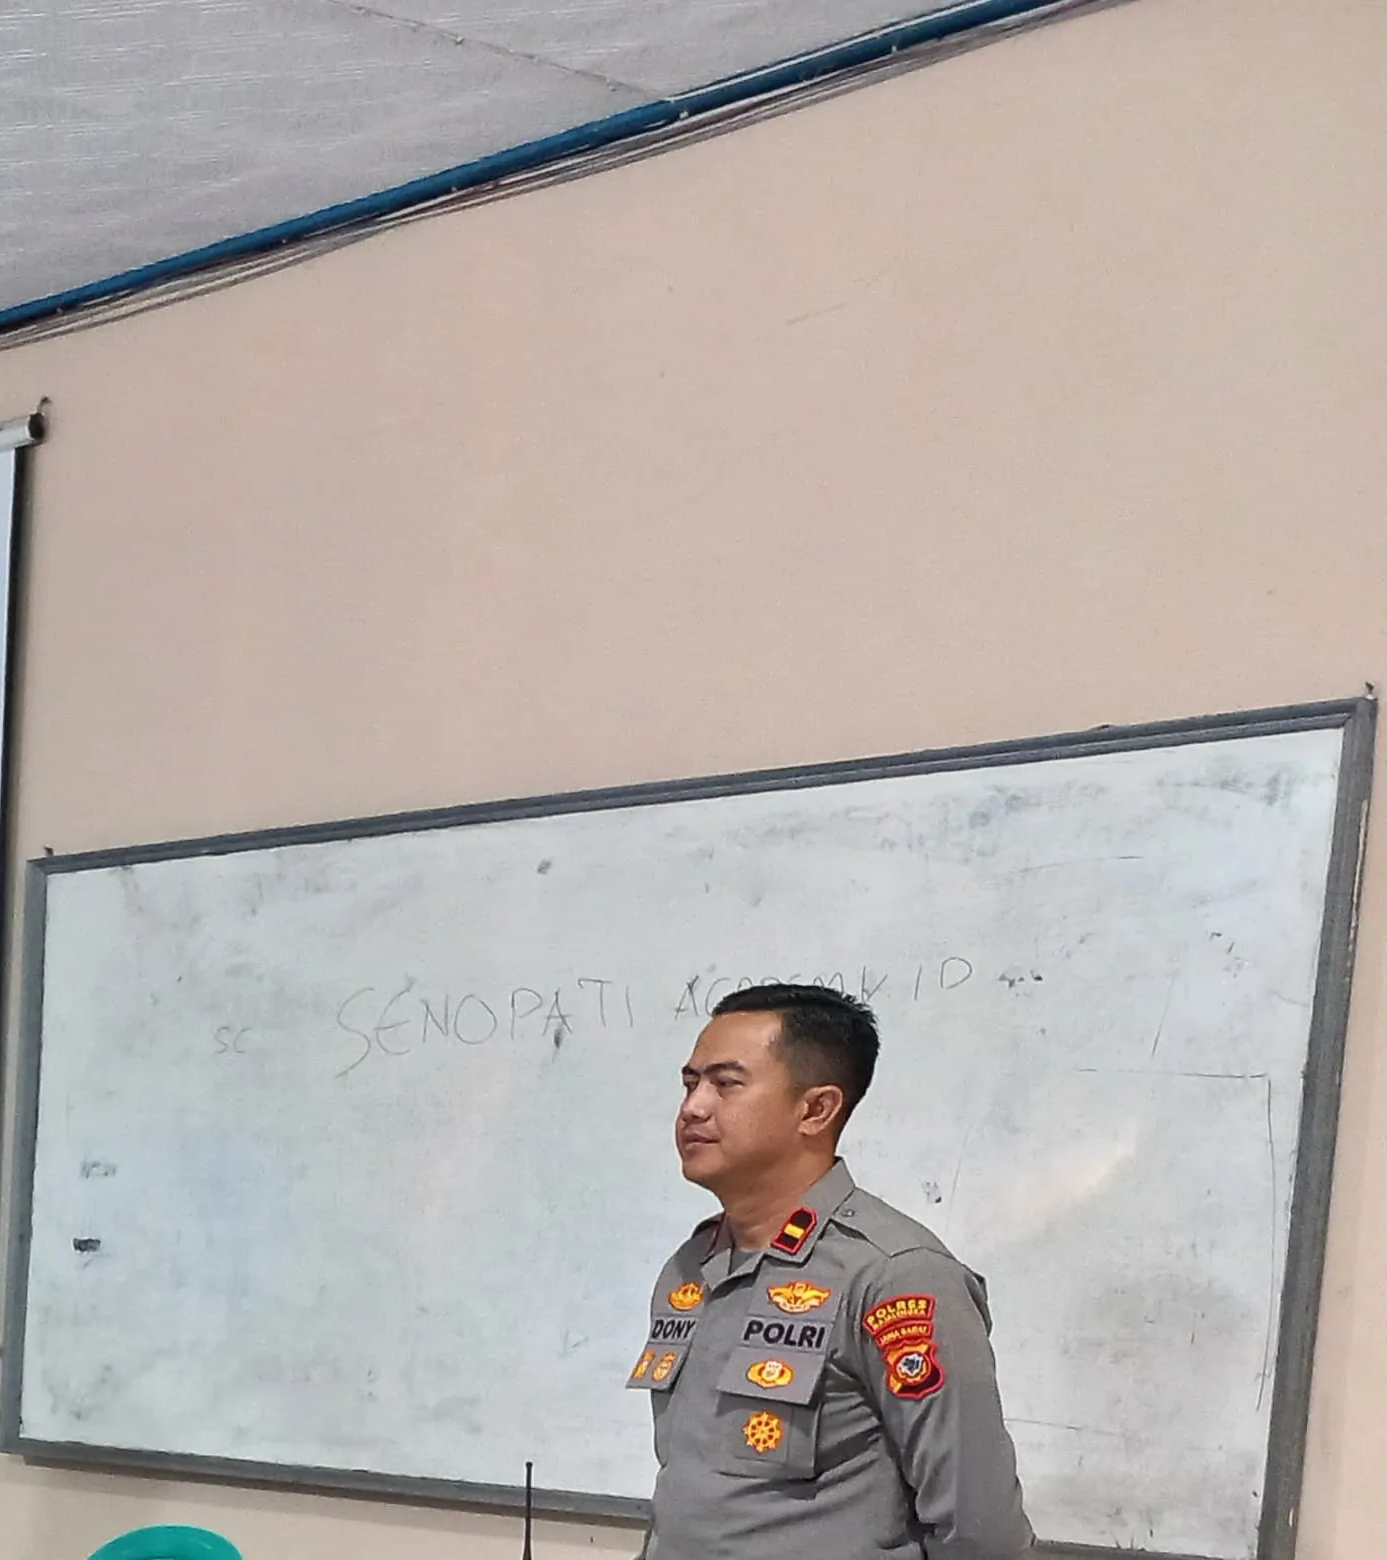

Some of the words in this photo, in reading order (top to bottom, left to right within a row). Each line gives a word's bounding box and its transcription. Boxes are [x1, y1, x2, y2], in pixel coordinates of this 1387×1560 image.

[336, 975, 635, 1077] SENOPATI
[651, 1318, 697, 1340] DONY
[742, 1319, 826, 1349] POLRI
